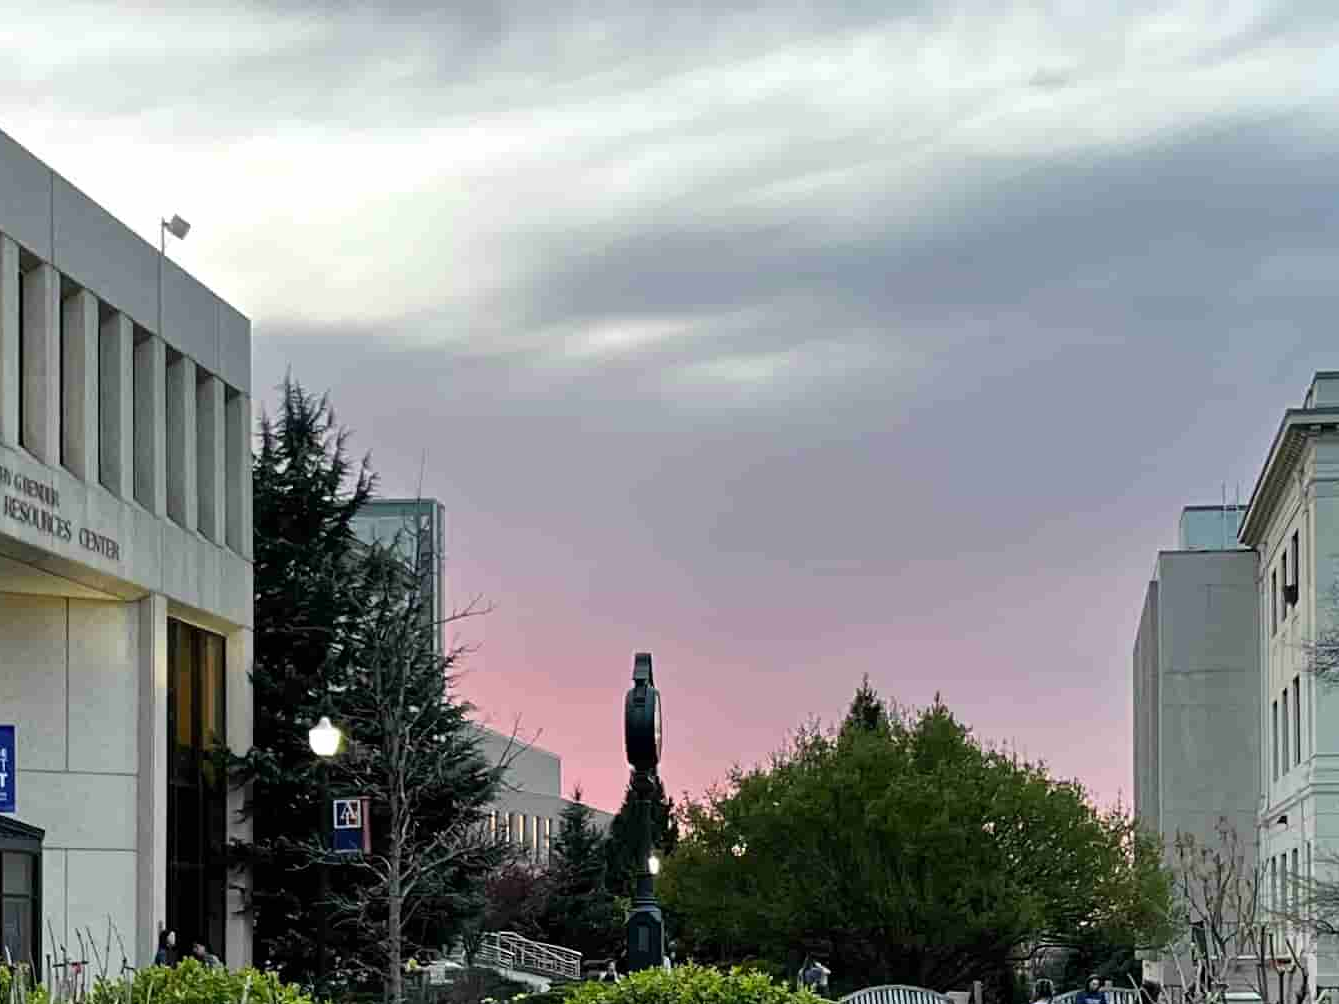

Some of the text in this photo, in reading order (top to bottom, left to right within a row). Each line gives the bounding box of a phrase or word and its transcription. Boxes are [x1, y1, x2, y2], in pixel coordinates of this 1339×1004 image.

[22, 476, 61, 509] BENDER
[5, 495, 73, 543] RESOURCES
[79, 528, 120, 561] CENTER
